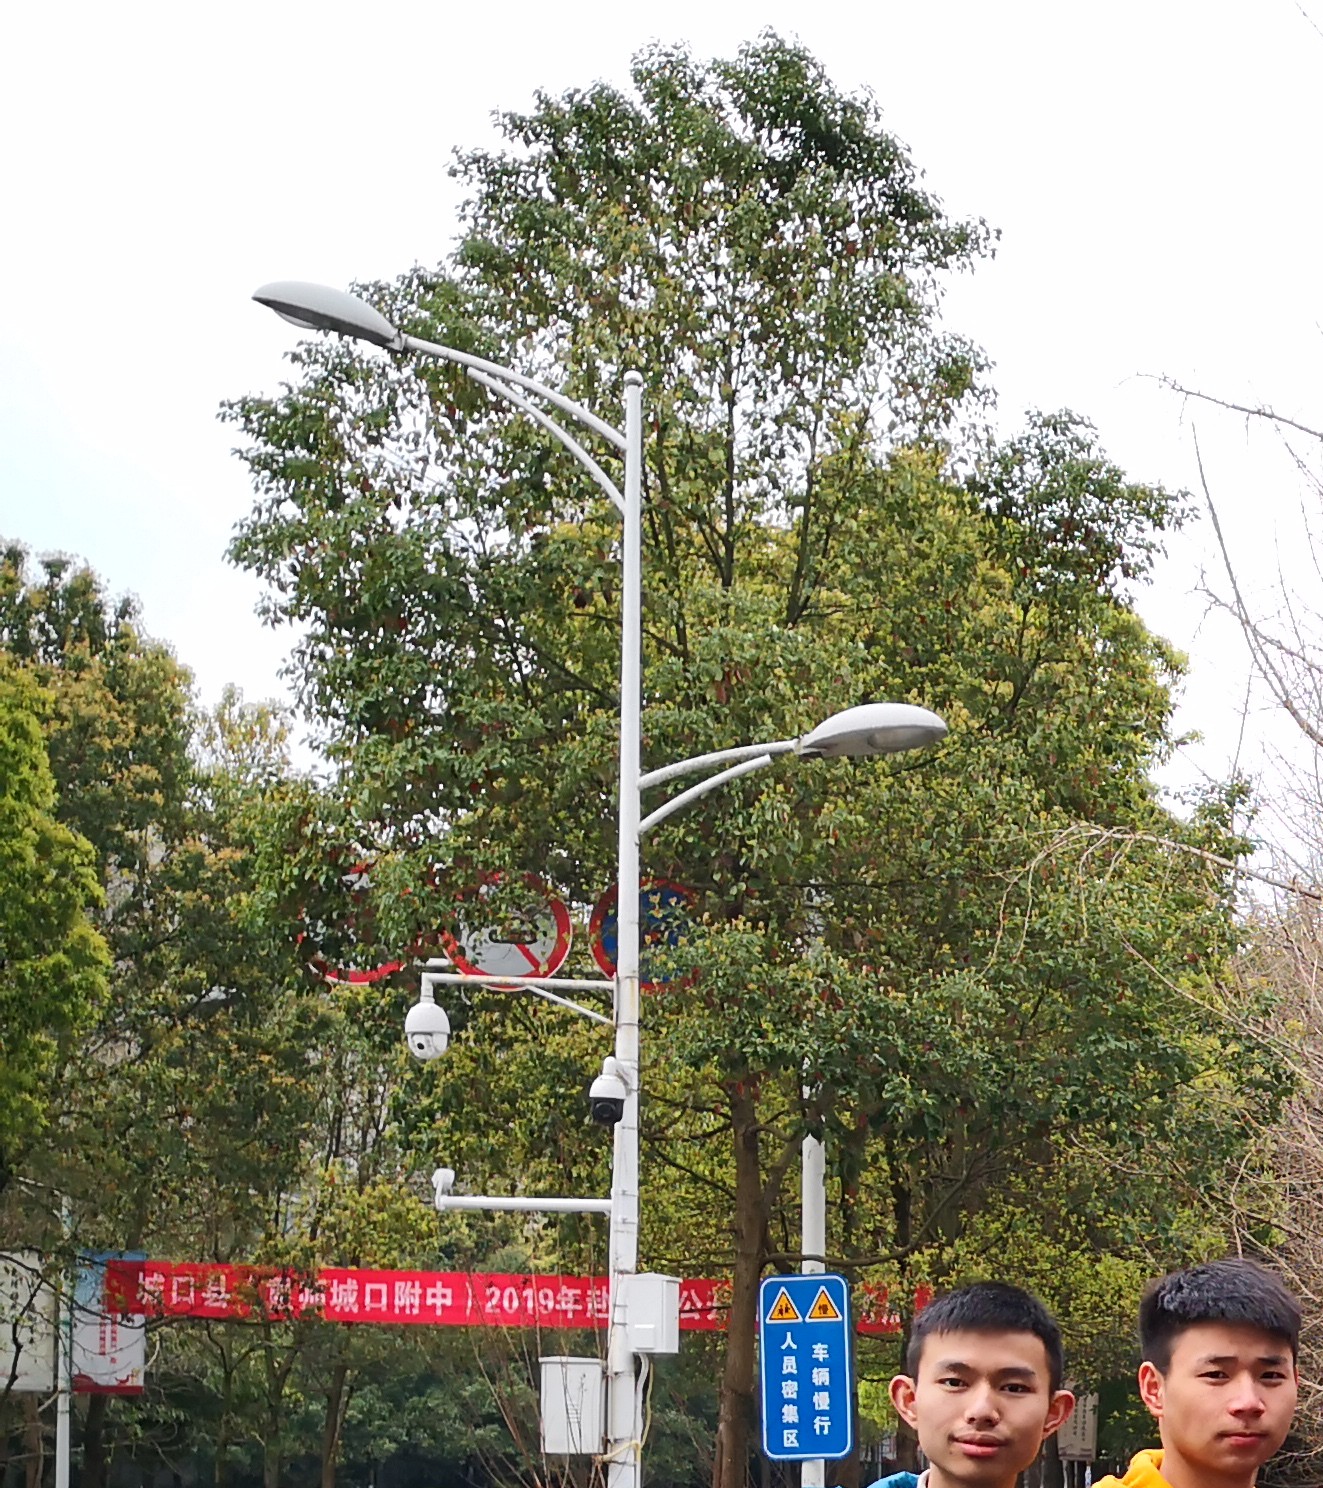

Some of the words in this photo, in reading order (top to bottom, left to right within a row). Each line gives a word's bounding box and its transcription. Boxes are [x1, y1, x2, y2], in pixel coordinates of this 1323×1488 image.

[780, 1331, 800, 1449] 人员密集区
[811, 1342, 832, 1436] 车辆慢行
